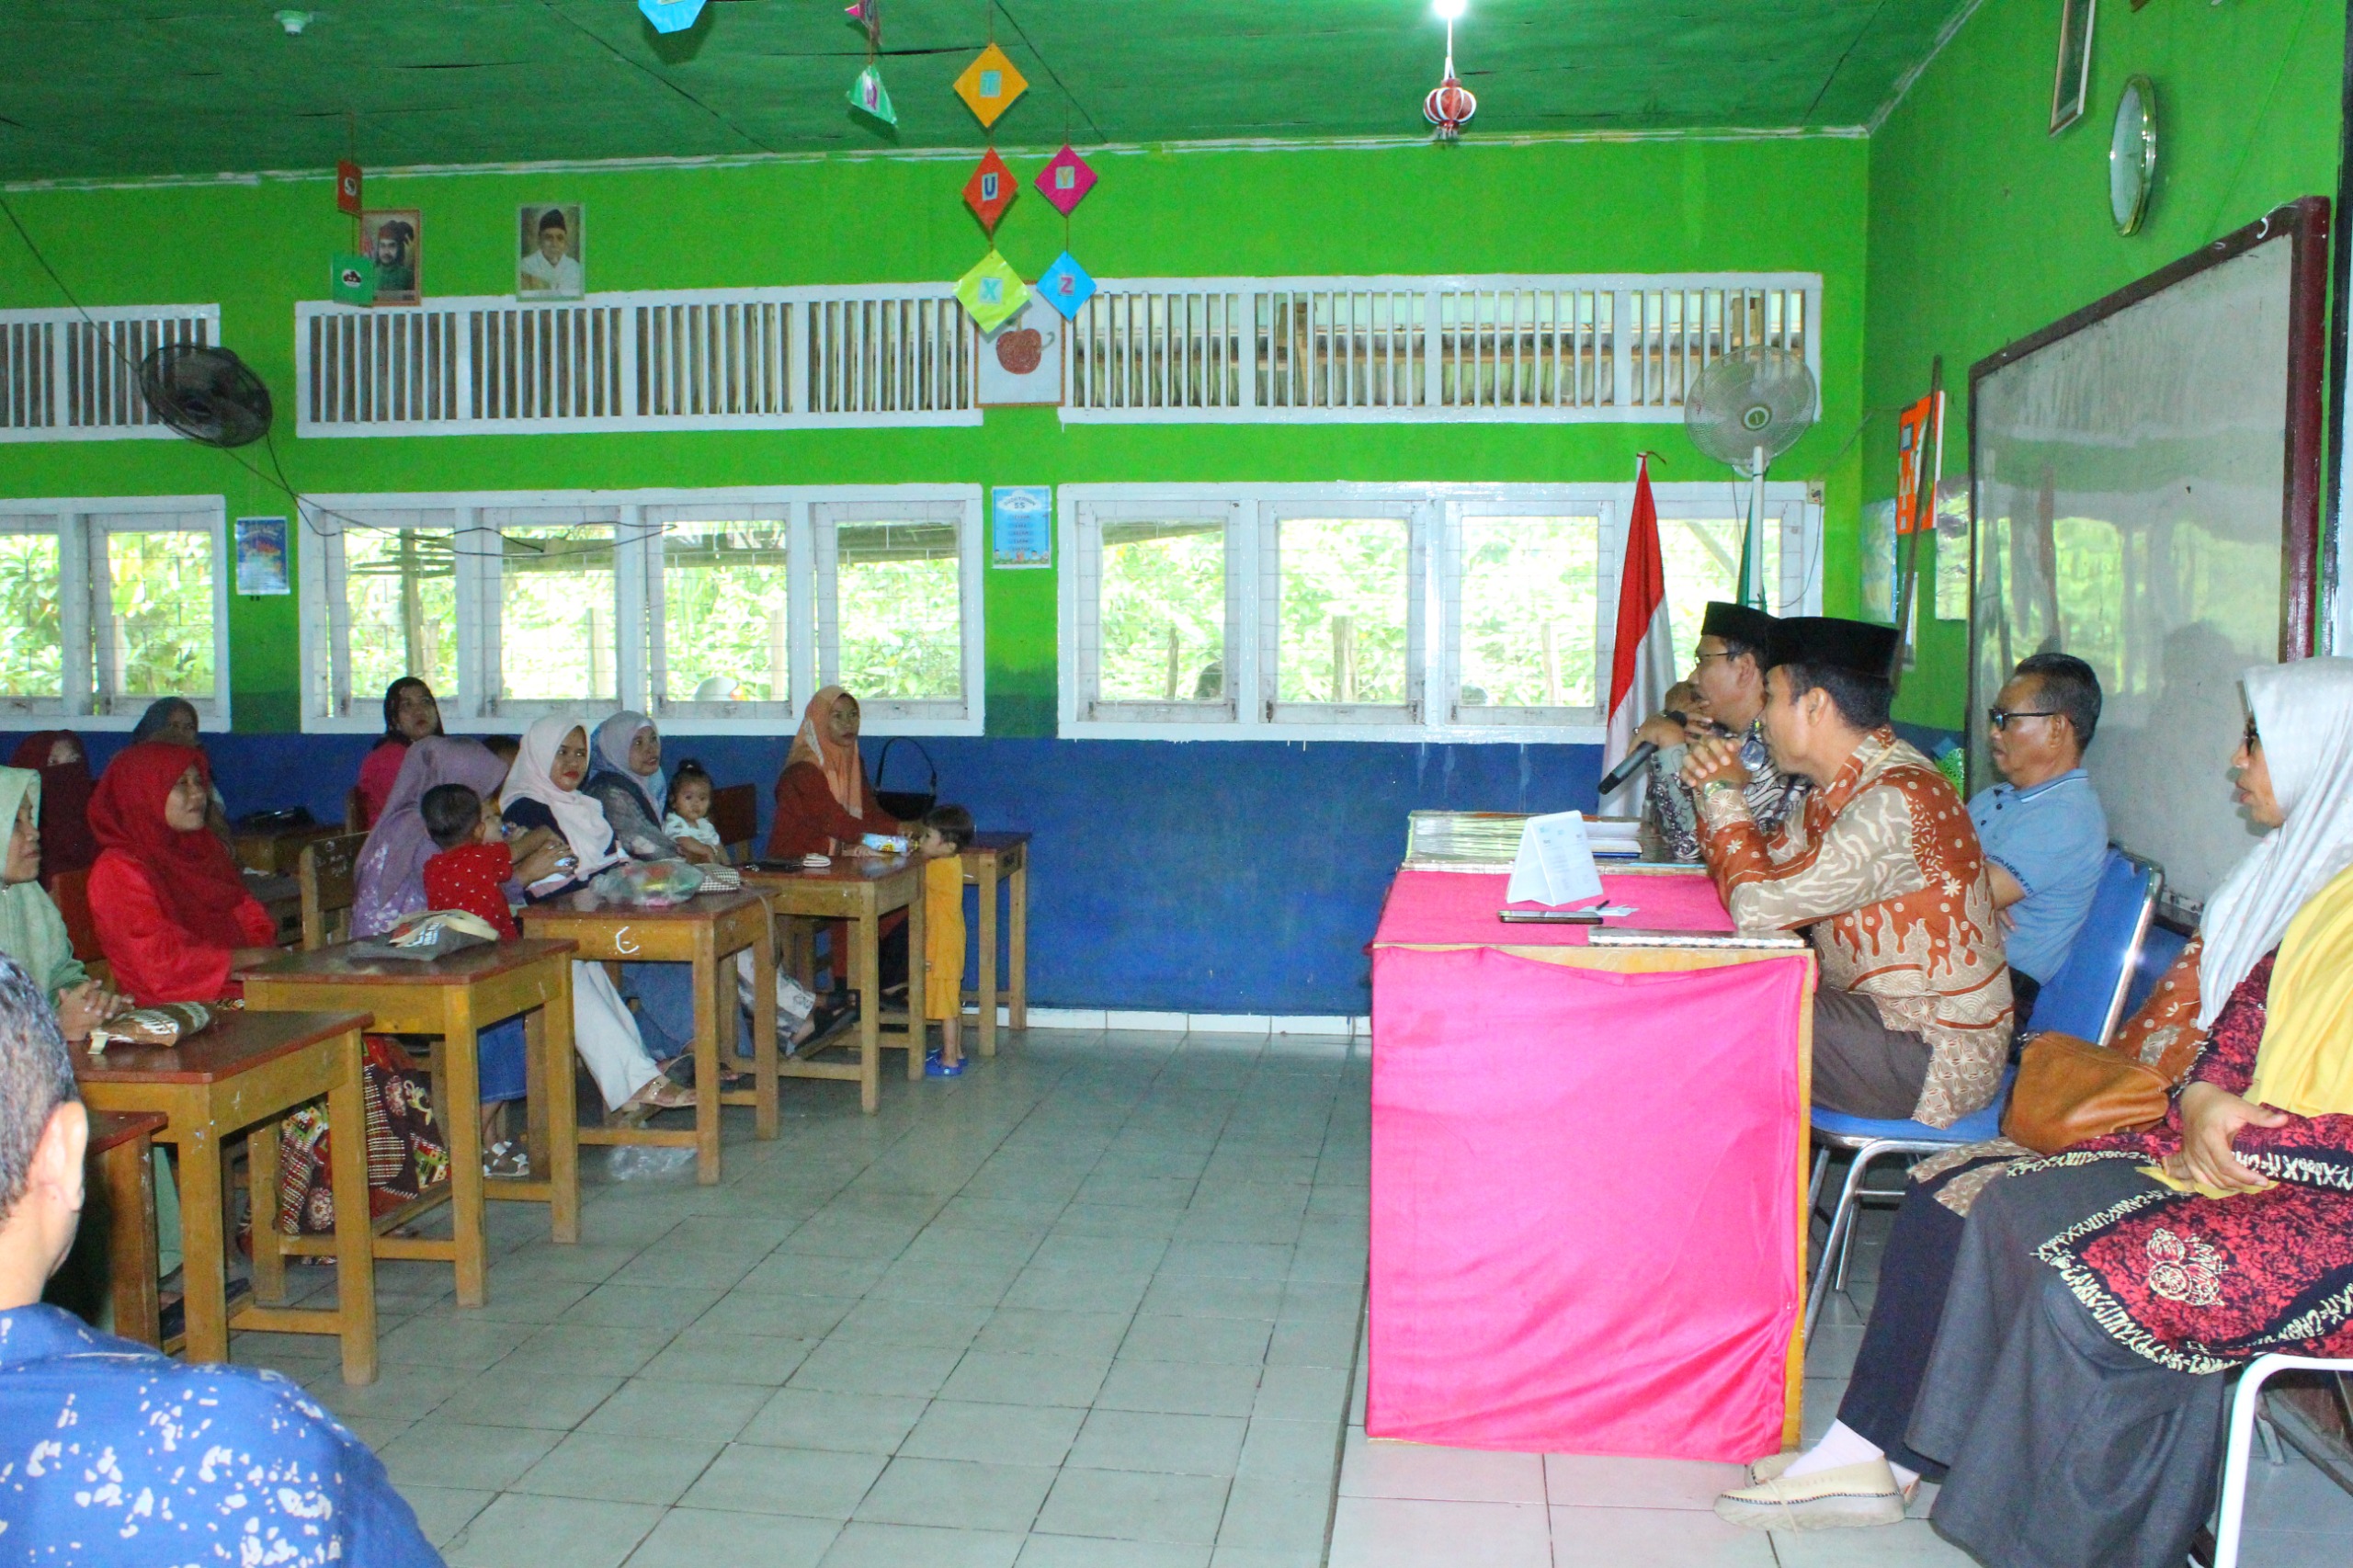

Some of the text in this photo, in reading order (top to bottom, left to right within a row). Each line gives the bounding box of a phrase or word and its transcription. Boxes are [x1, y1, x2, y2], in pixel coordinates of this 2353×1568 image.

[982, 72, 997, 95] T
[984, 176, 995, 196] U
[1059, 168, 1071, 187] Y
[981, 278, 997, 300] X
[1061, 277, 1073, 293] Z
